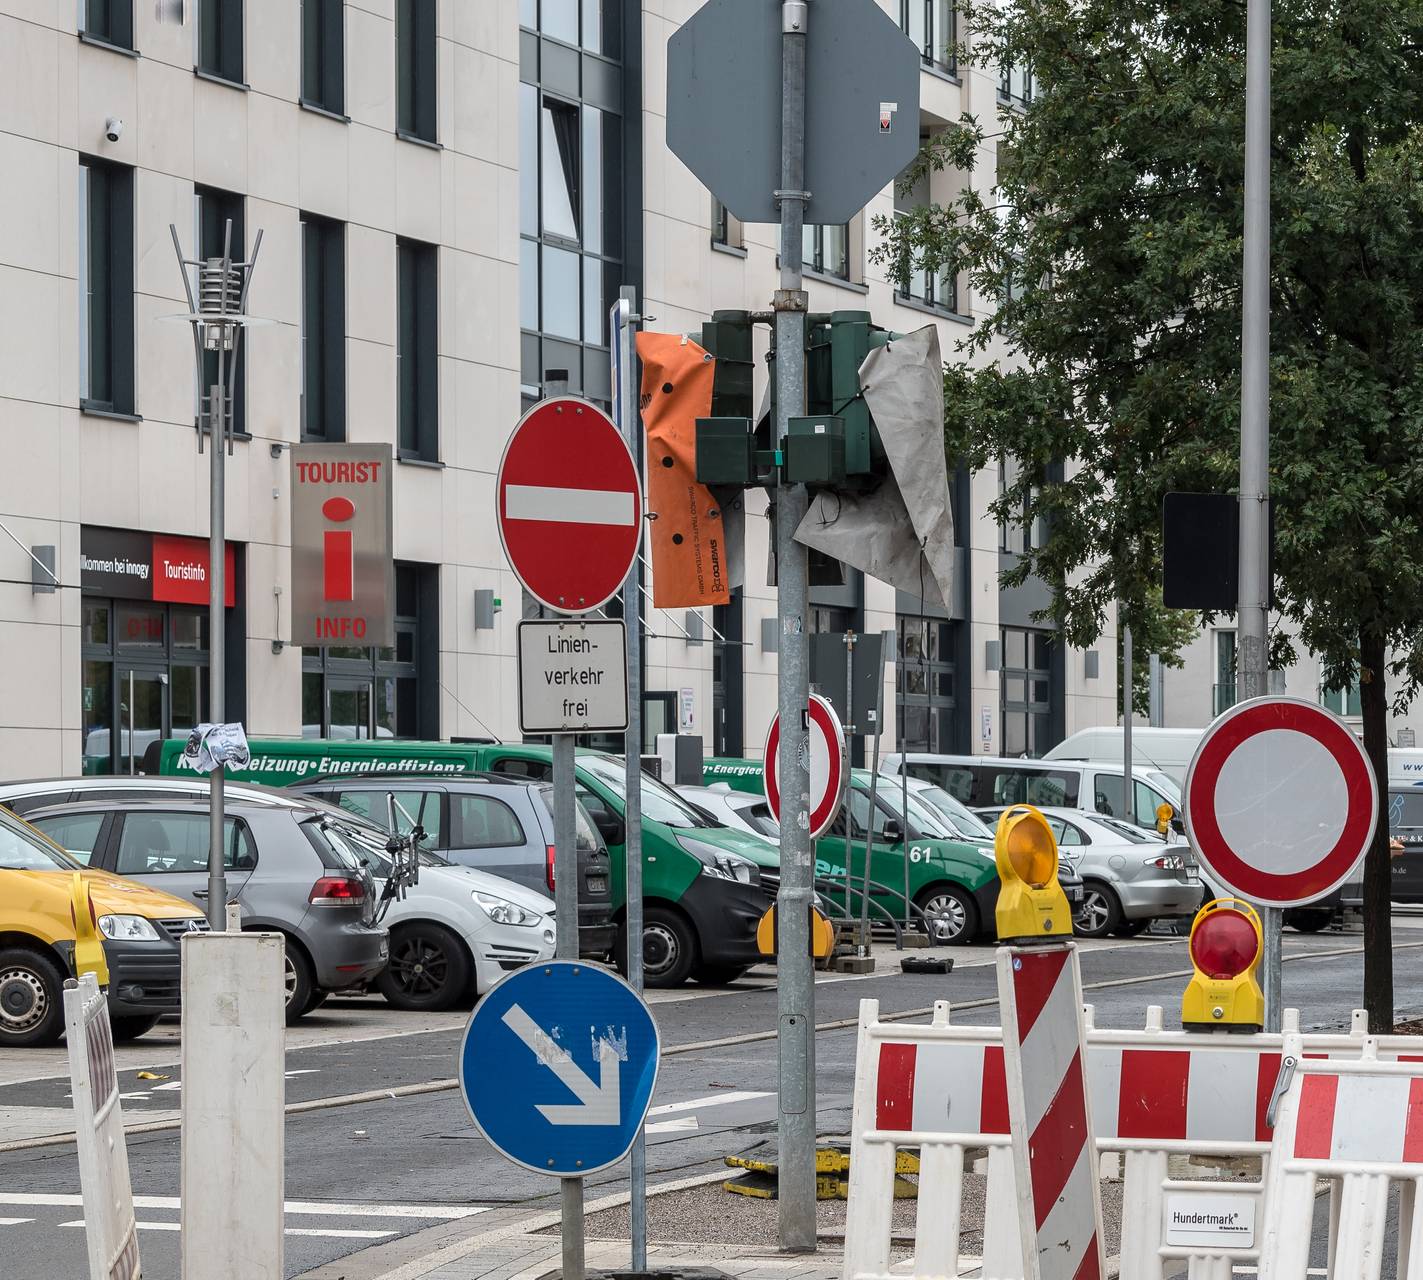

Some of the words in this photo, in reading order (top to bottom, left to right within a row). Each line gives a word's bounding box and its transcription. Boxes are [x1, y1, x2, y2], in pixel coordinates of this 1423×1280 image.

[295, 461, 381, 484] TOURIST
[114, 557, 125, 574] bei
[125, 558, 150, 579] innogy
[164, 560, 206, 582] Touristinfo
[316, 617, 367, 639] INFO
[548, 635, 598, 653] Linien-
[544, 667, 604, 685] verkehr
[563, 698, 588, 716] frei
[910, 846, 931, 863] 61
